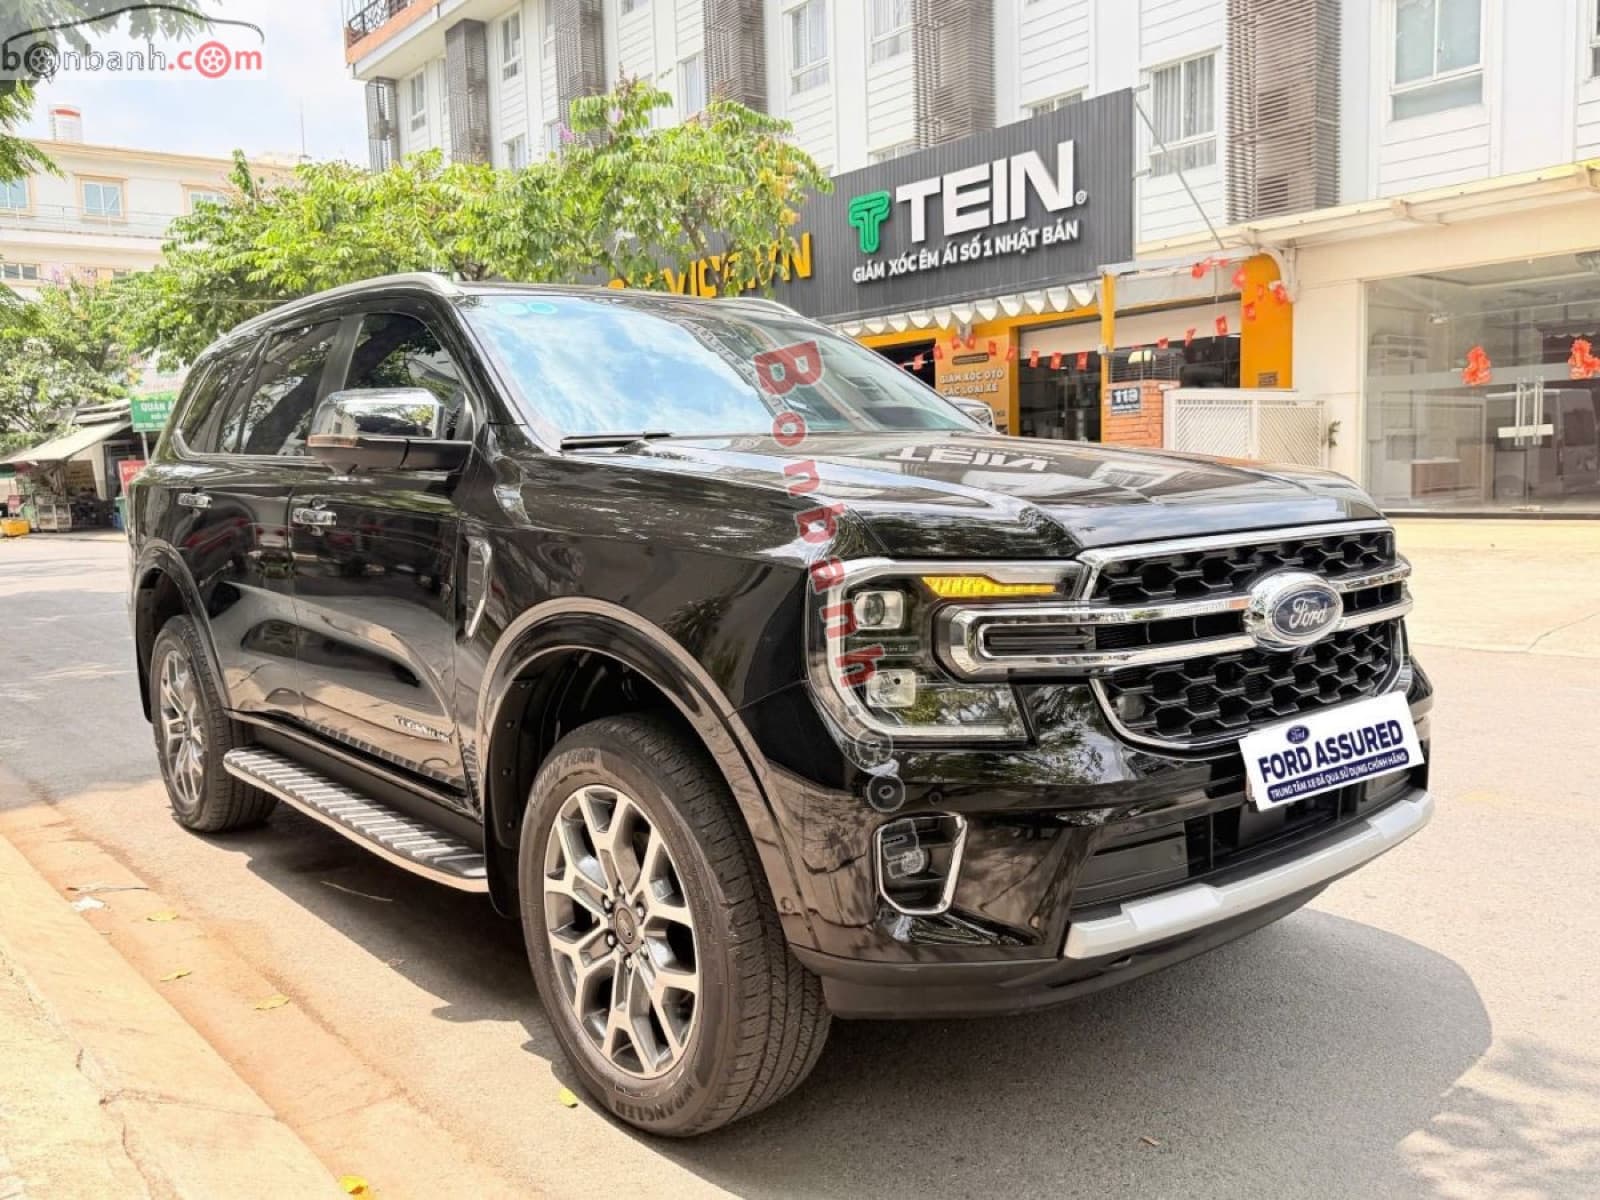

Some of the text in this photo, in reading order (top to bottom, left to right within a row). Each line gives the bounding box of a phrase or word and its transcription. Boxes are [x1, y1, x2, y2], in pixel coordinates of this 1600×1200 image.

[895, 139, 1075, 243] TEIN
[888, 250, 917, 276] XÓC
[919, 248, 939, 270] ÊM
[942, 241, 958, 265] ÁI
[960, 234, 981, 260] SỐ
[983, 240, 993, 257] 1
[995, 227, 1039, 254] NHẬT
[1042, 217, 1079, 245] BẢN
[1289, 597, 1328, 629] Ford
[1258, 719, 1404, 783] FORD ASSURED
